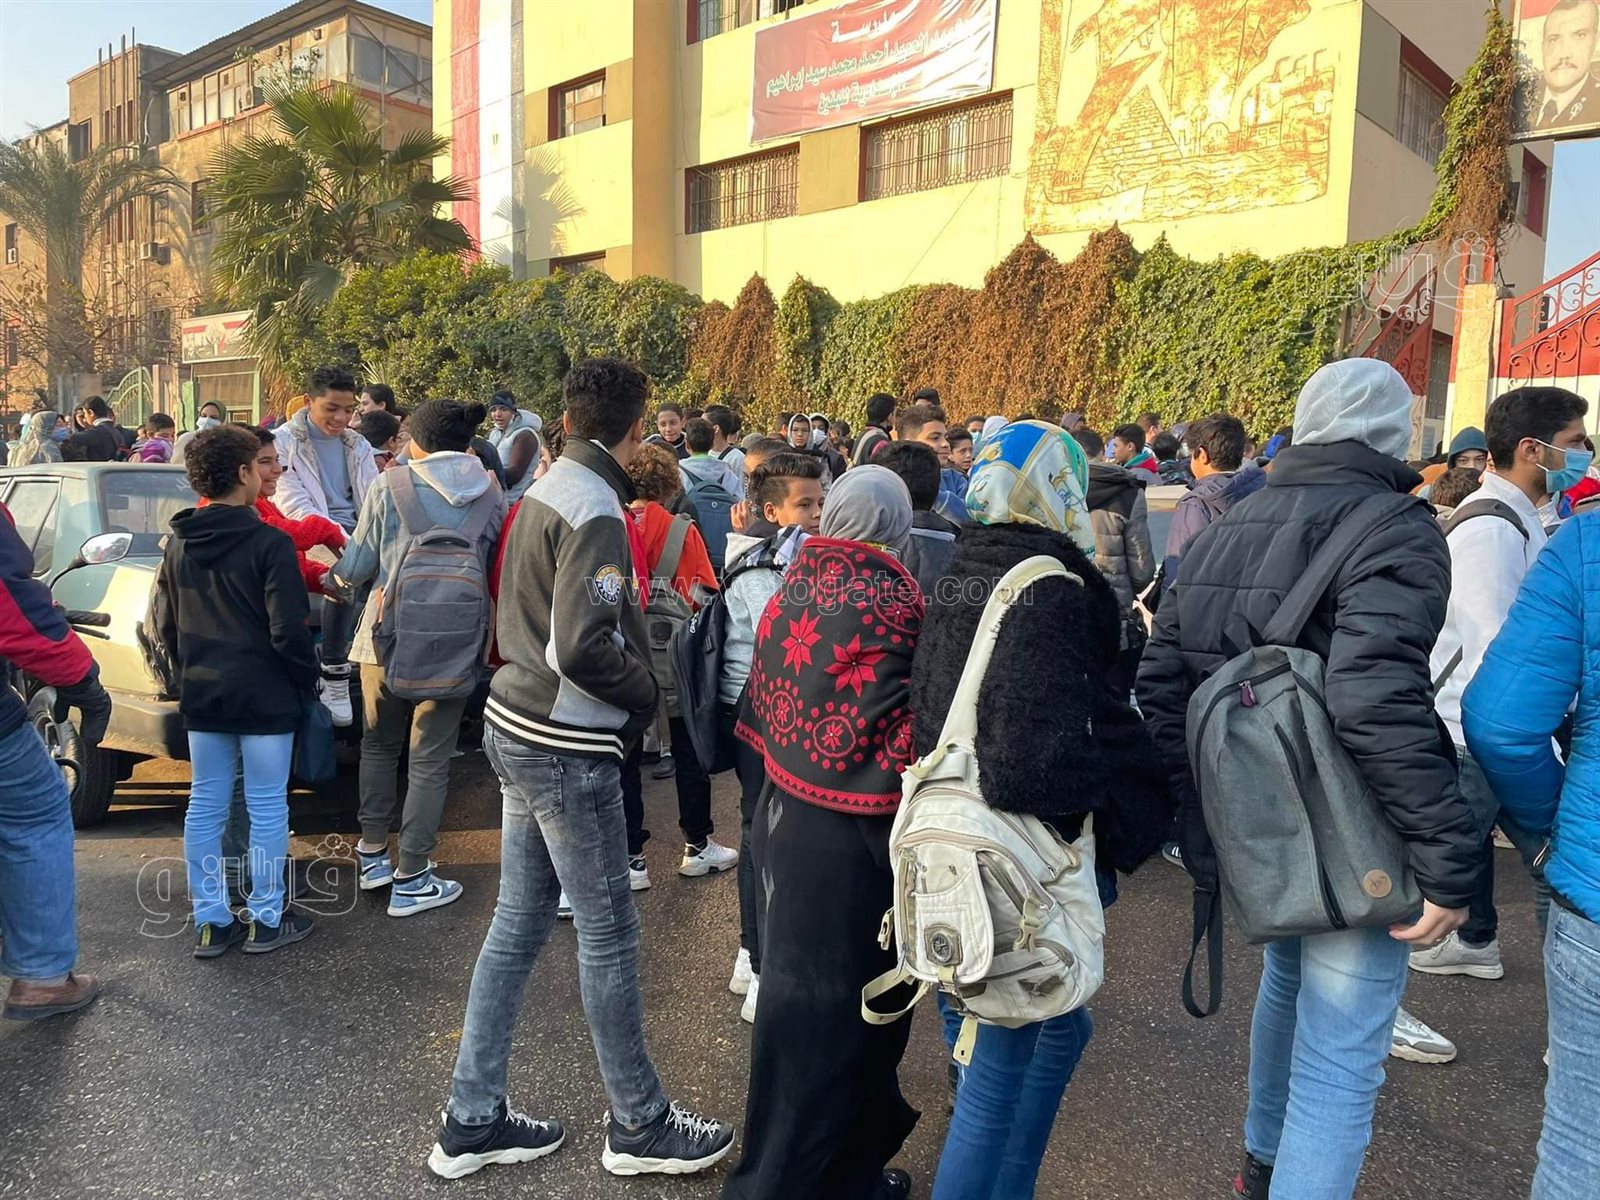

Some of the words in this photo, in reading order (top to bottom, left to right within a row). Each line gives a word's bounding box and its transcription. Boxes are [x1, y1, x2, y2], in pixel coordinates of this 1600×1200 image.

[805, 65, 827, 86] سيد
[828, 57, 858, 77] محمد
[817, 86, 850, 115] للبنين
